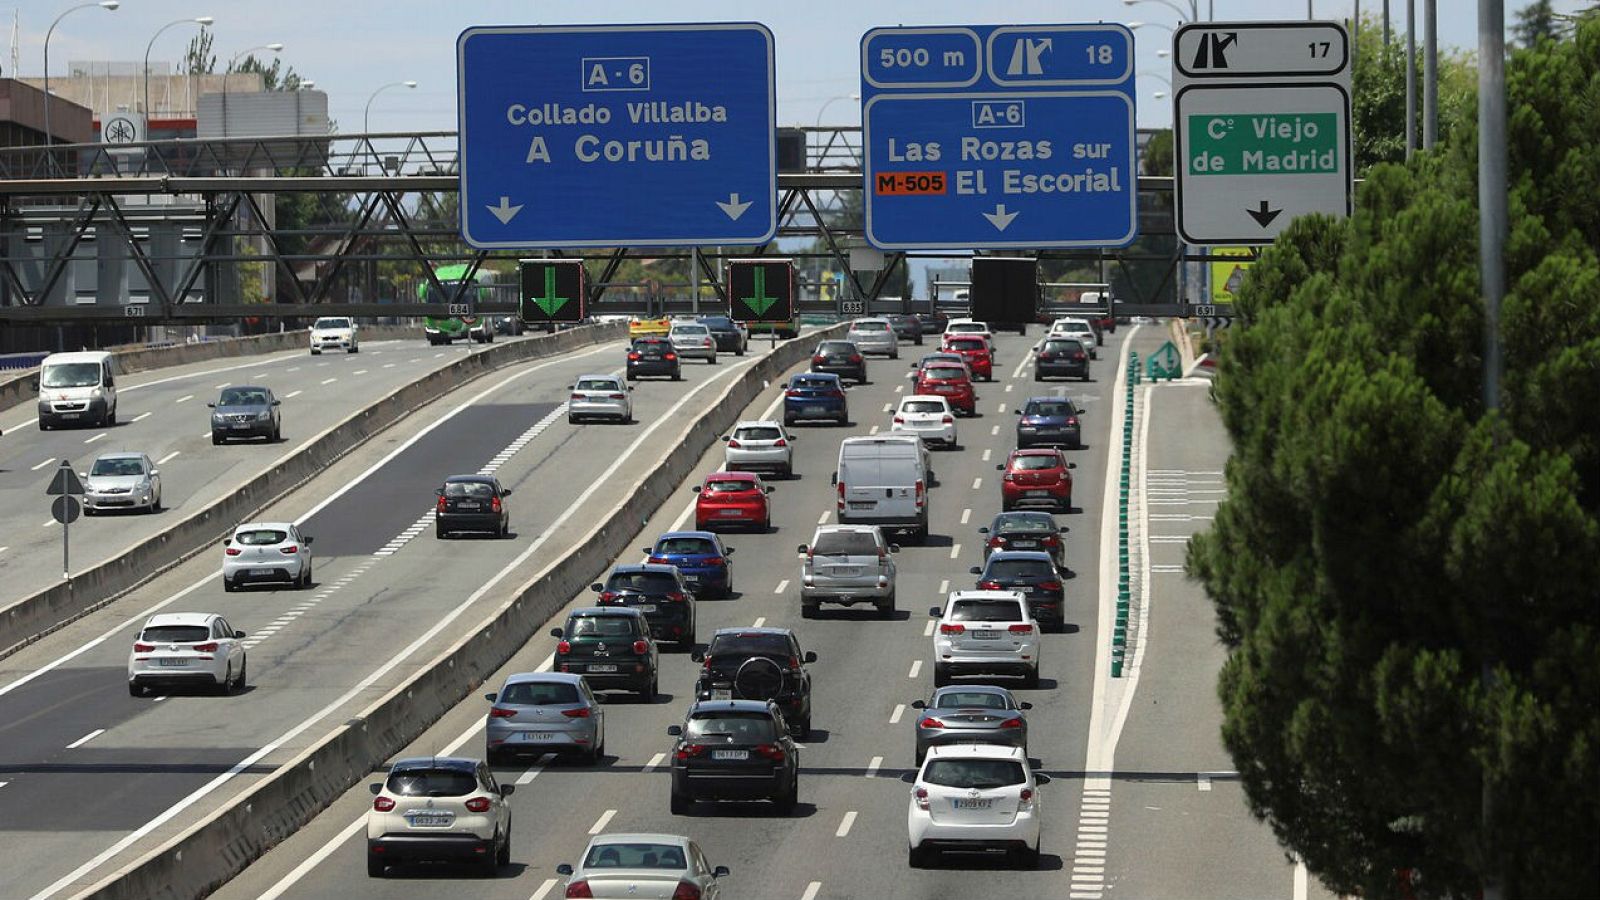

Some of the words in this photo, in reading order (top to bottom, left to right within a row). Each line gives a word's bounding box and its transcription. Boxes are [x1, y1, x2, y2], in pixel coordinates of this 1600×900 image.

[880, 48, 930, 68] 500
[943, 51, 966, 67] m
[1086, 44, 1114, 65] 18
[1308, 42, 1331, 59] 17
[507, 103, 612, 126] Collado
[627, 101, 728, 125] Villalba
[977, 104, 1021, 125] A-6
[1252, 117, 1319, 142] Viejo
[525, 136, 552, 164] A
[574, 134, 712, 164] Coruña
[888, 138, 942, 162] Las
[961, 136, 1053, 162] Rozas
[1073, 143, 1113, 159] sur
[1194, 151, 1225, 172] de
[1242, 149, 1335, 171] Madrid
[879, 176, 943, 192] M-505
[957, 169, 988, 196] El
[1003, 166, 1122, 195] Escorial
